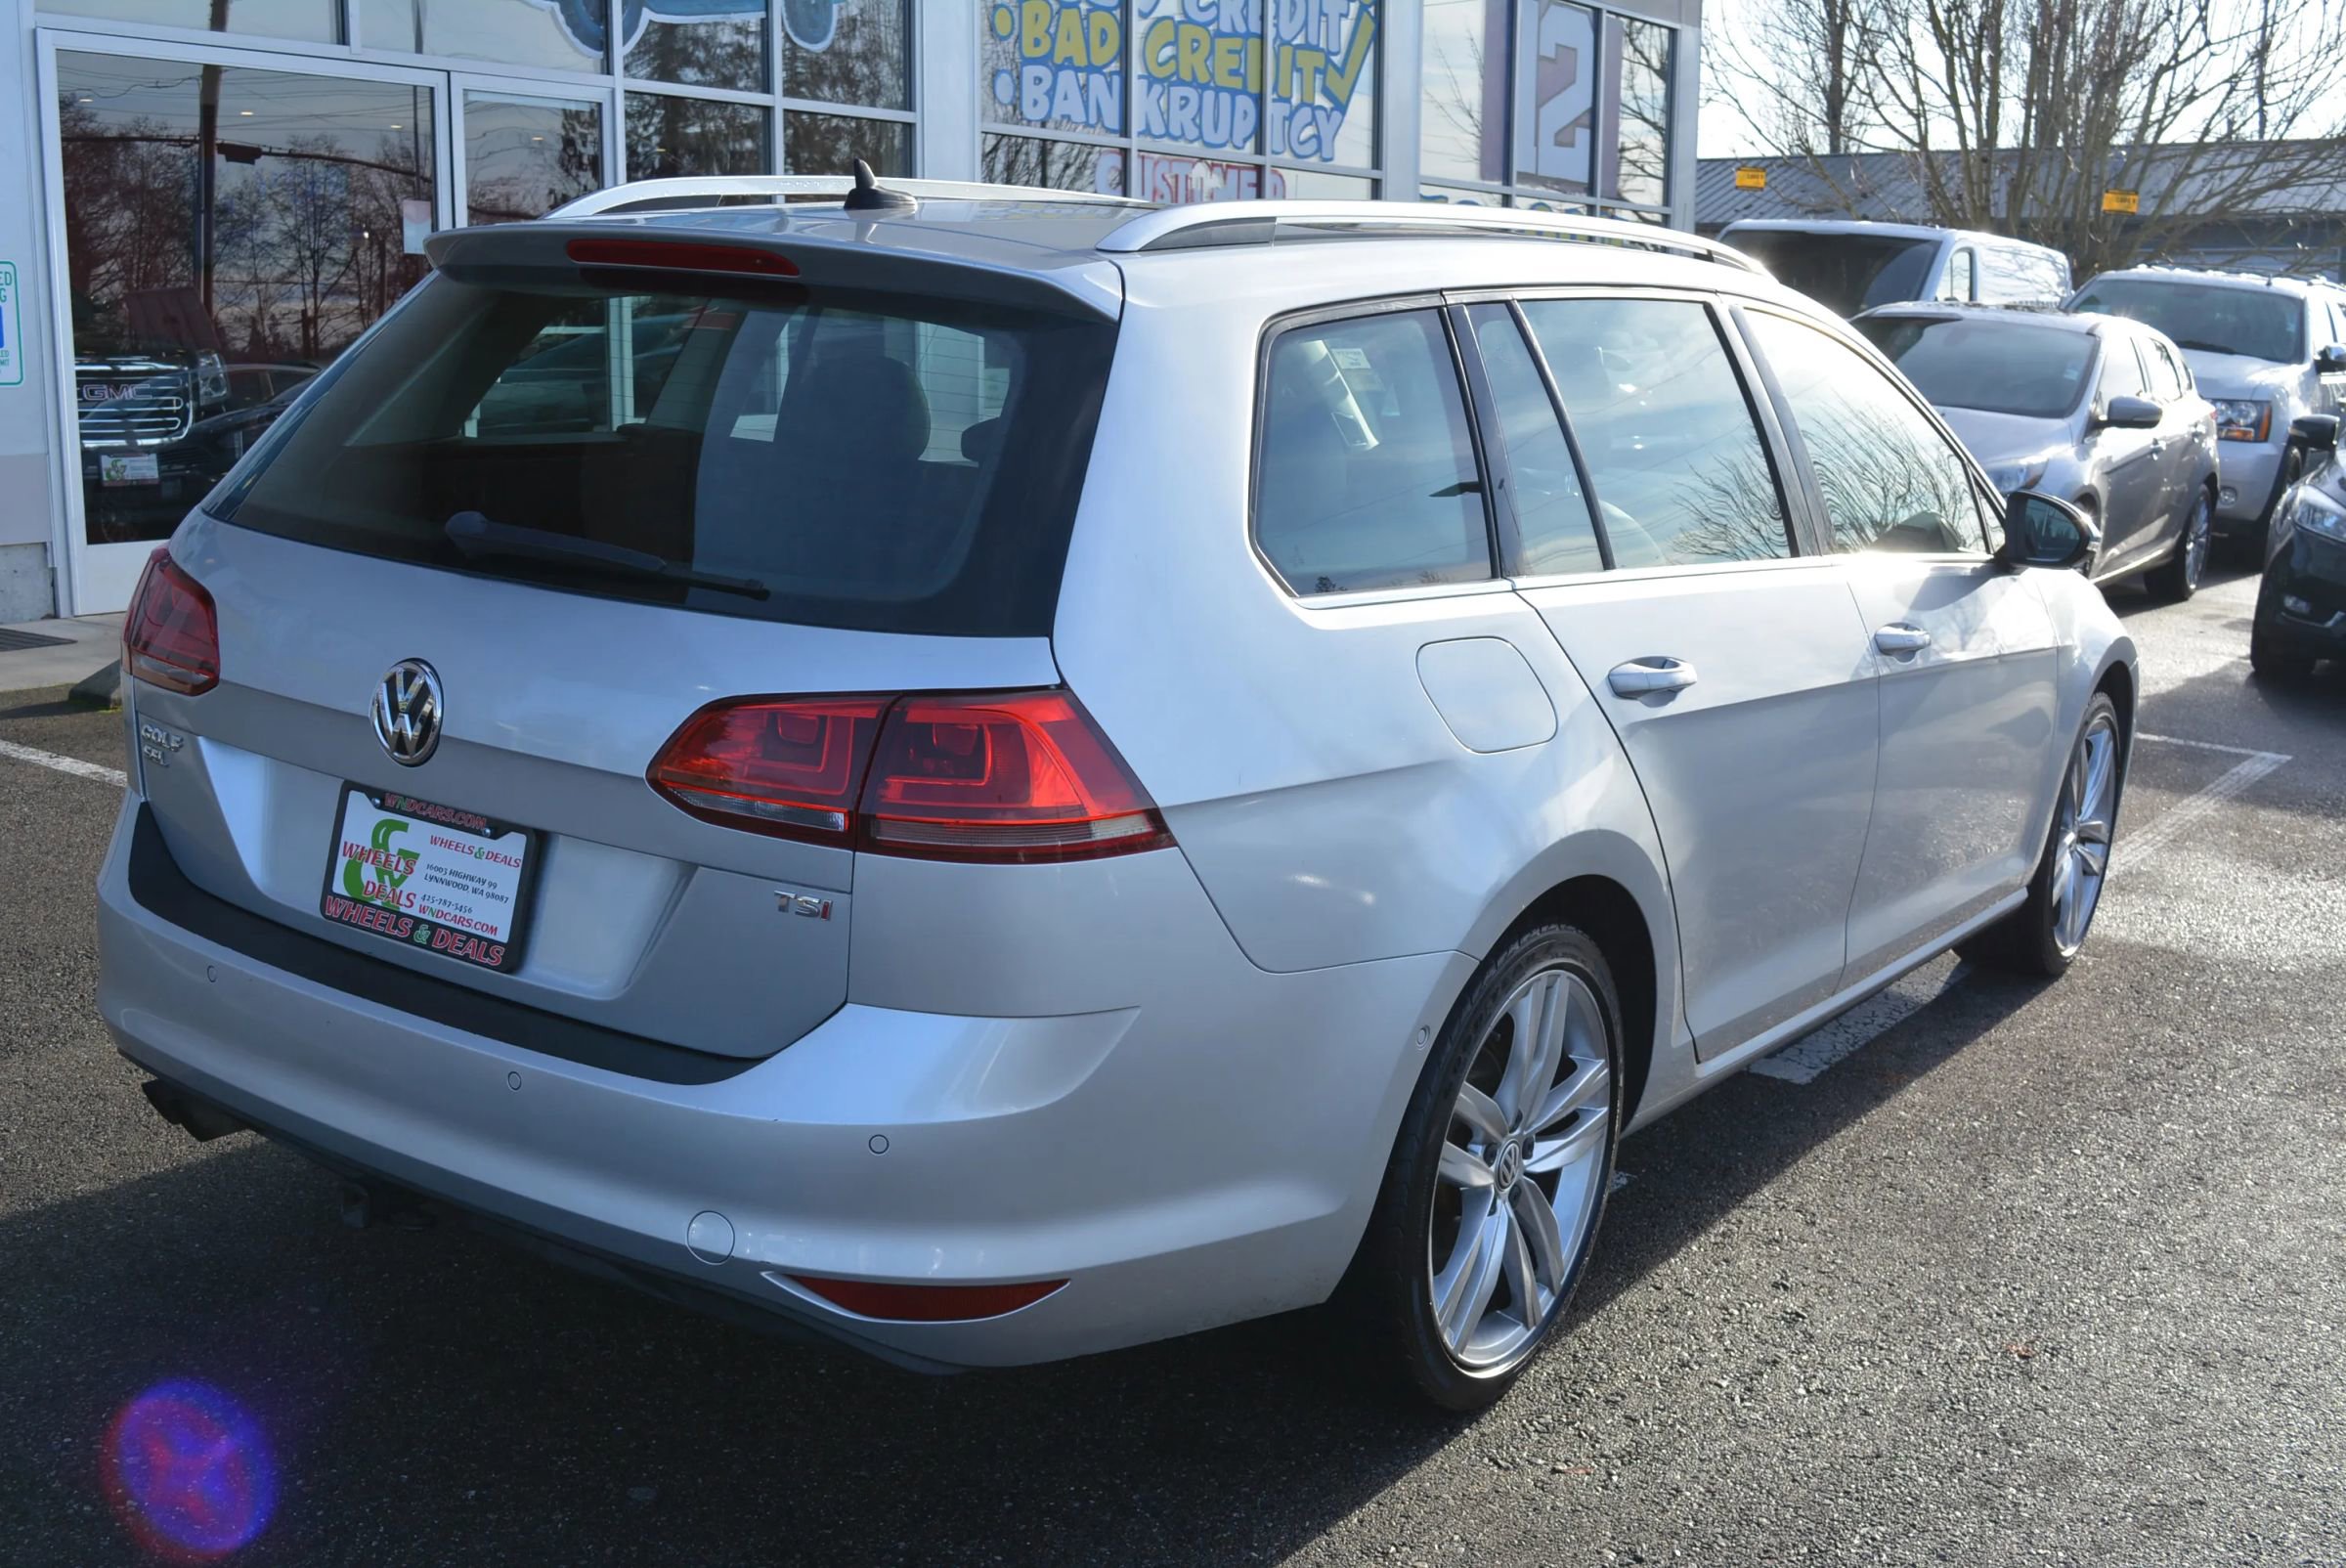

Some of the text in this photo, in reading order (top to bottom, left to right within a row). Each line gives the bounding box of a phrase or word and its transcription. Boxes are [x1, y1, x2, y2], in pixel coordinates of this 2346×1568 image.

[1021, 1, 1326, 105] BAD CREDIT
[82, 384, 152, 401] GMC
[384, 792, 488, 829] WNDCARS.COM
[342, 841, 417, 876] WHEELS
[430, 835, 522, 868] WHEELS & DEALS
[426, 863, 498, 891] 16003 HIGHWAY 99
[363, 880, 417, 909] DEALS
[471, 886, 485, 896] WA
[485, 892, 509, 904] 98087
[773, 890, 833, 921] TSI
[325, 895, 505, 966] WHEELS & DEALS
[418, 903, 499, 936] WNDCARS.COM
